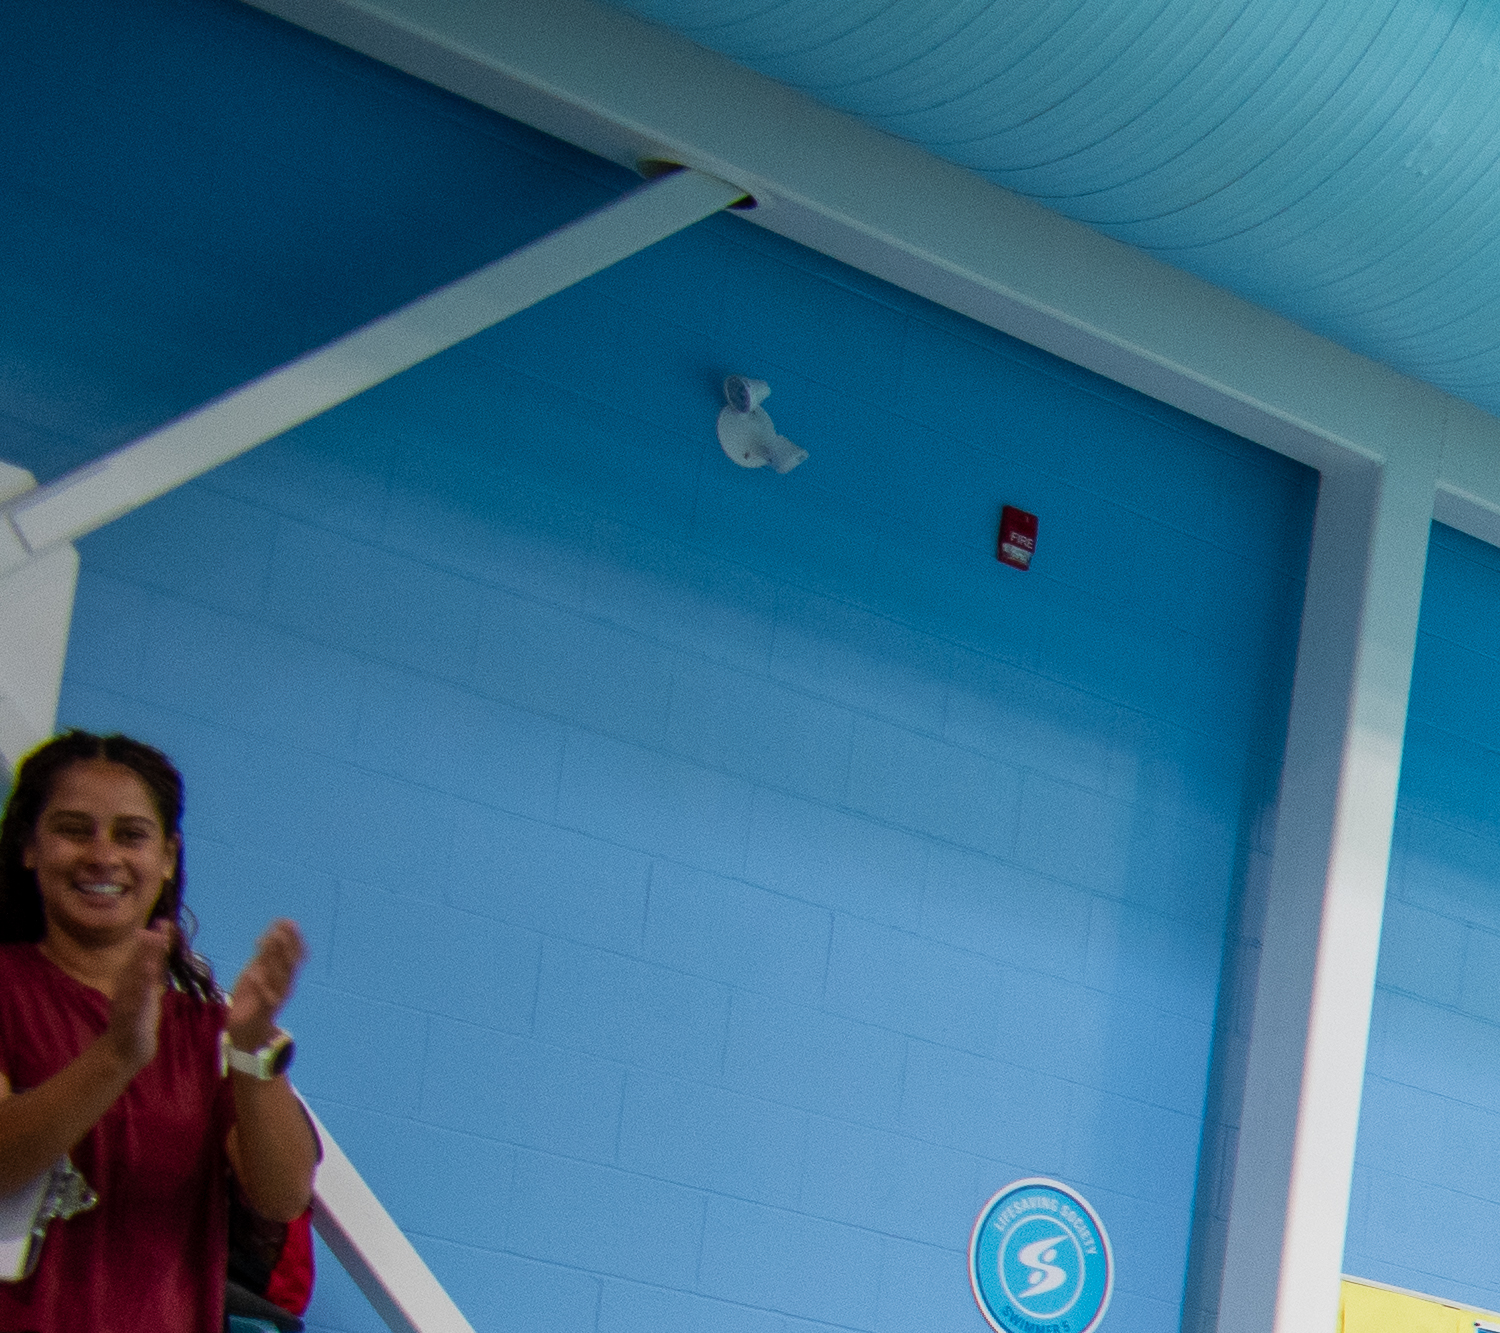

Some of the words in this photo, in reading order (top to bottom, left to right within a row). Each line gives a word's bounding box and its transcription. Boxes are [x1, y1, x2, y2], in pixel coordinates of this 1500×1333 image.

[1009, 531, 1034, 550] FIRE
[993, 1196, 1059, 1232] LIFESAVING
[1059, 1204, 1098, 1256] SOCIETY
